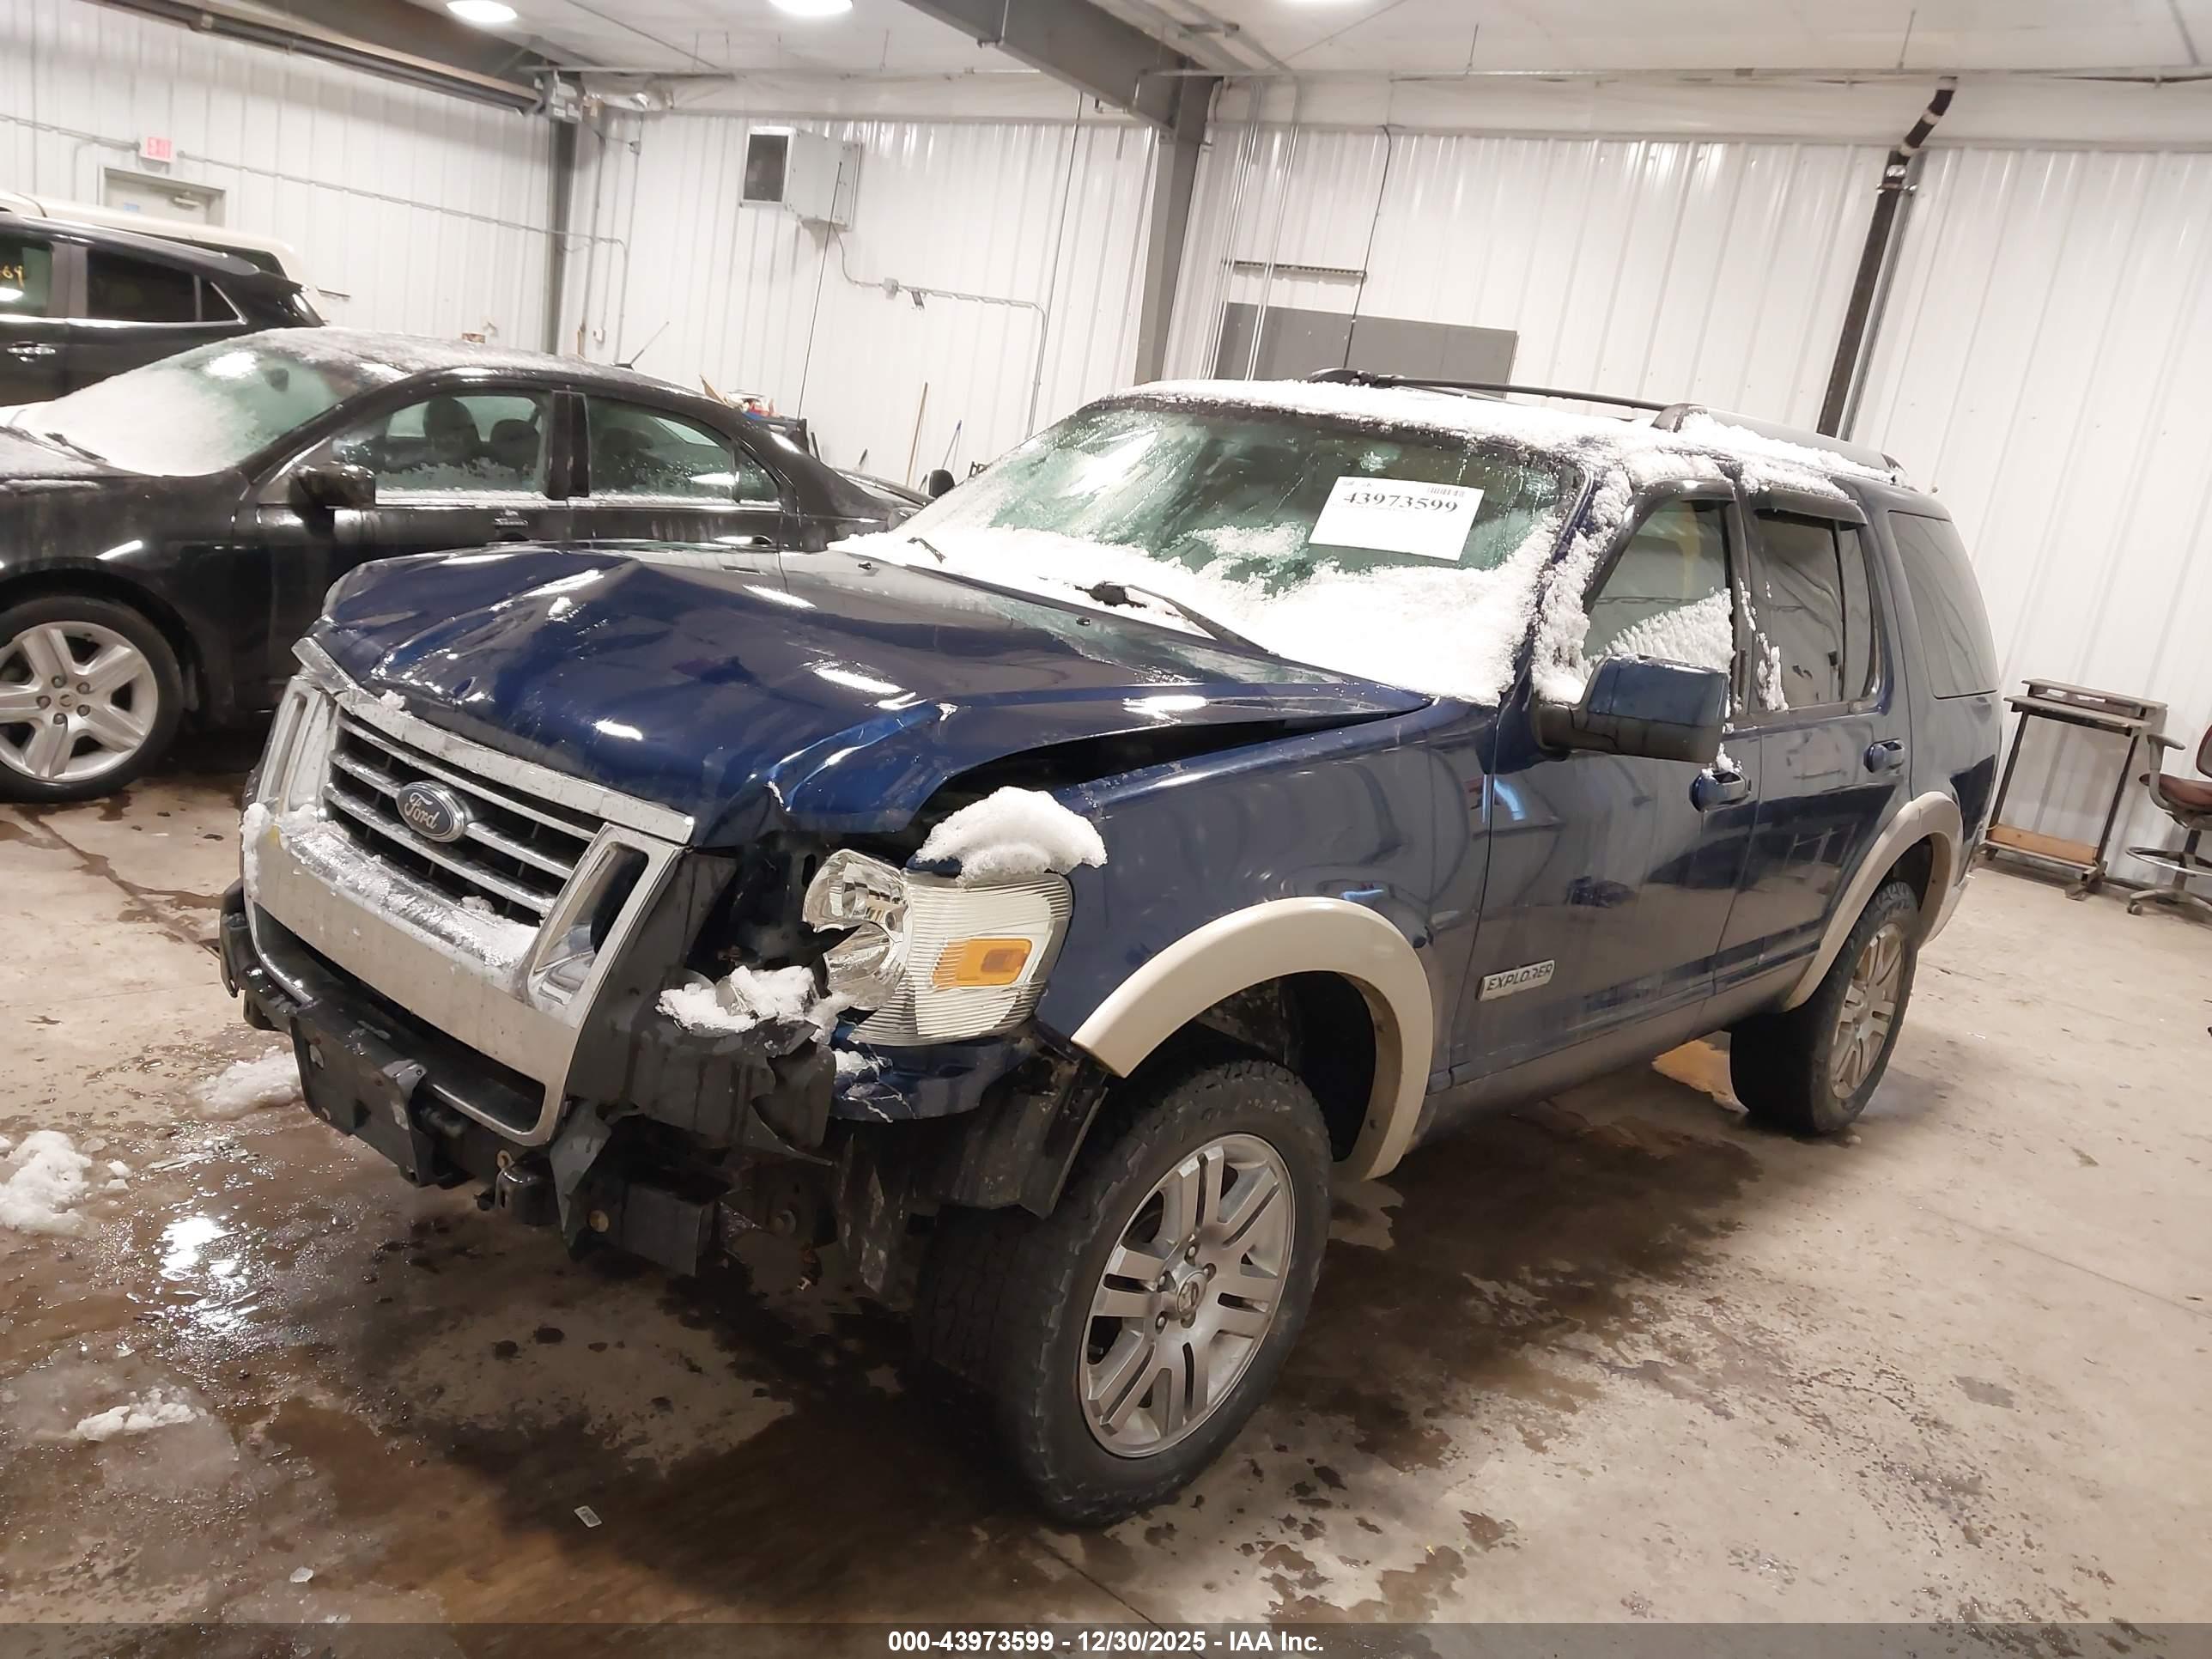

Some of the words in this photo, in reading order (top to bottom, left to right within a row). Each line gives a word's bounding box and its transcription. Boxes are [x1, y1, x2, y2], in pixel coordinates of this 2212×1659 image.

[1343, 491, 1459, 514] 43973599
[404, 792, 441, 830] Ford
[1486, 963, 1553, 992] EXPLORER
